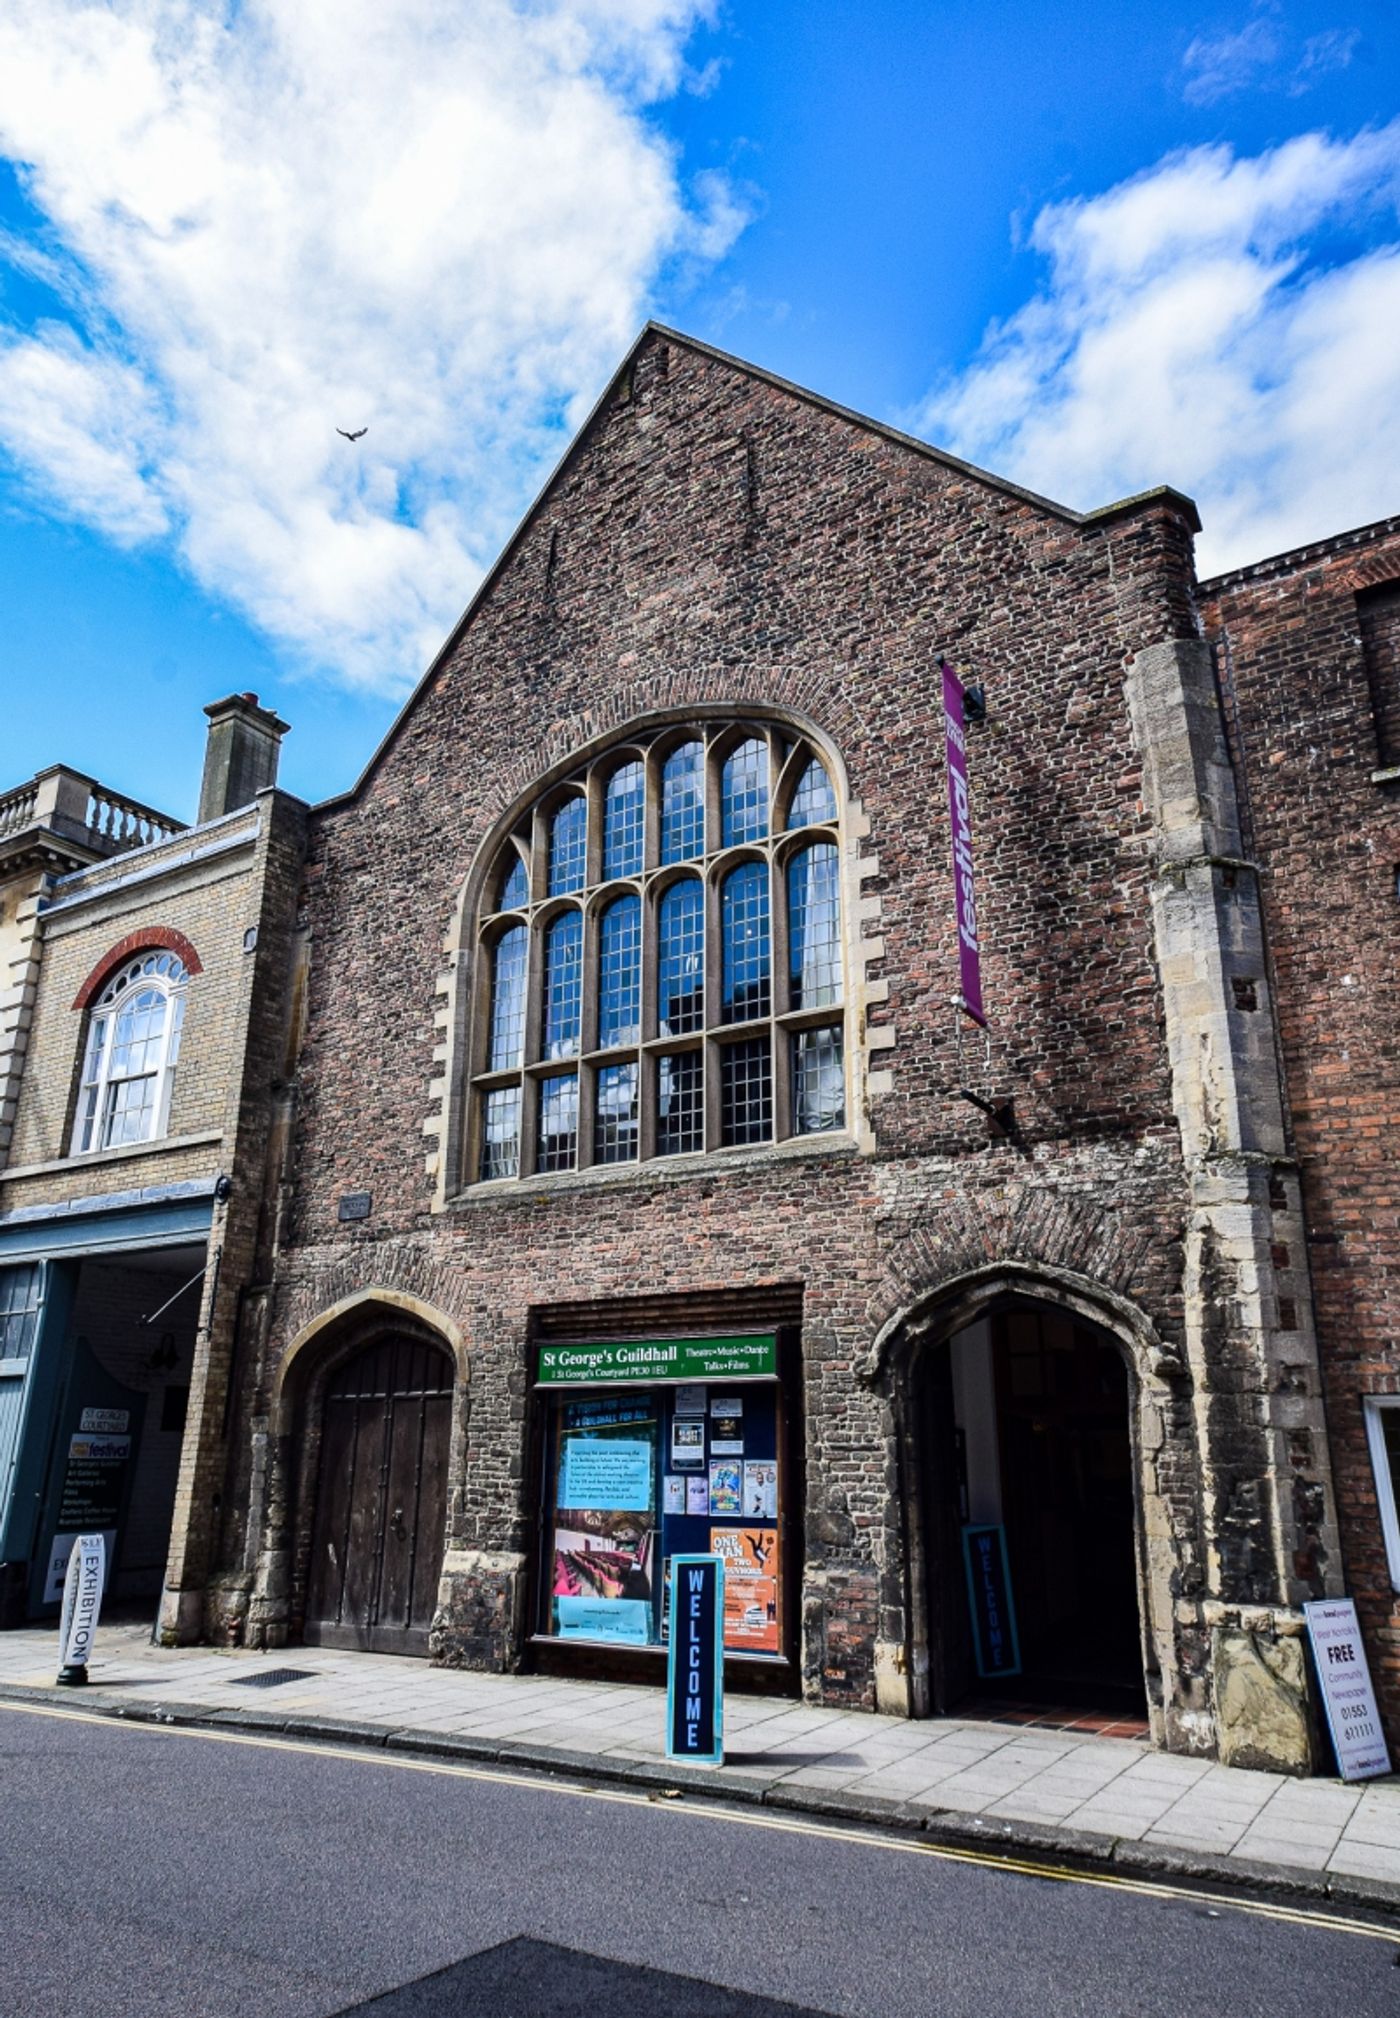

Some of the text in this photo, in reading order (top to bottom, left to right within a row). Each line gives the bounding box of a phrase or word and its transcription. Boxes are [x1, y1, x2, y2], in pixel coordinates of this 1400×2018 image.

[949, 763, 979, 950] festival
[543, 1346, 678, 1368] St George's Guildhall
[556, 1369, 565, 1379] St
[565, 1368, 594, 1380] George's
[595, 1367, 630, 1379] Courtyard
[89, 1441, 129, 1457] festival
[713, 1534, 738, 1549] ONE
[72, 1555, 99, 1659] EXHIBITION
[977, 1535, 1003, 1666] WELCOME
[686, 1569, 705, 1747] WELCOME
[1326, 1643, 1356, 1665] FREE
[1328, 1668, 1364, 1684] Community
[1340, 1703, 1368, 1720] 01553
